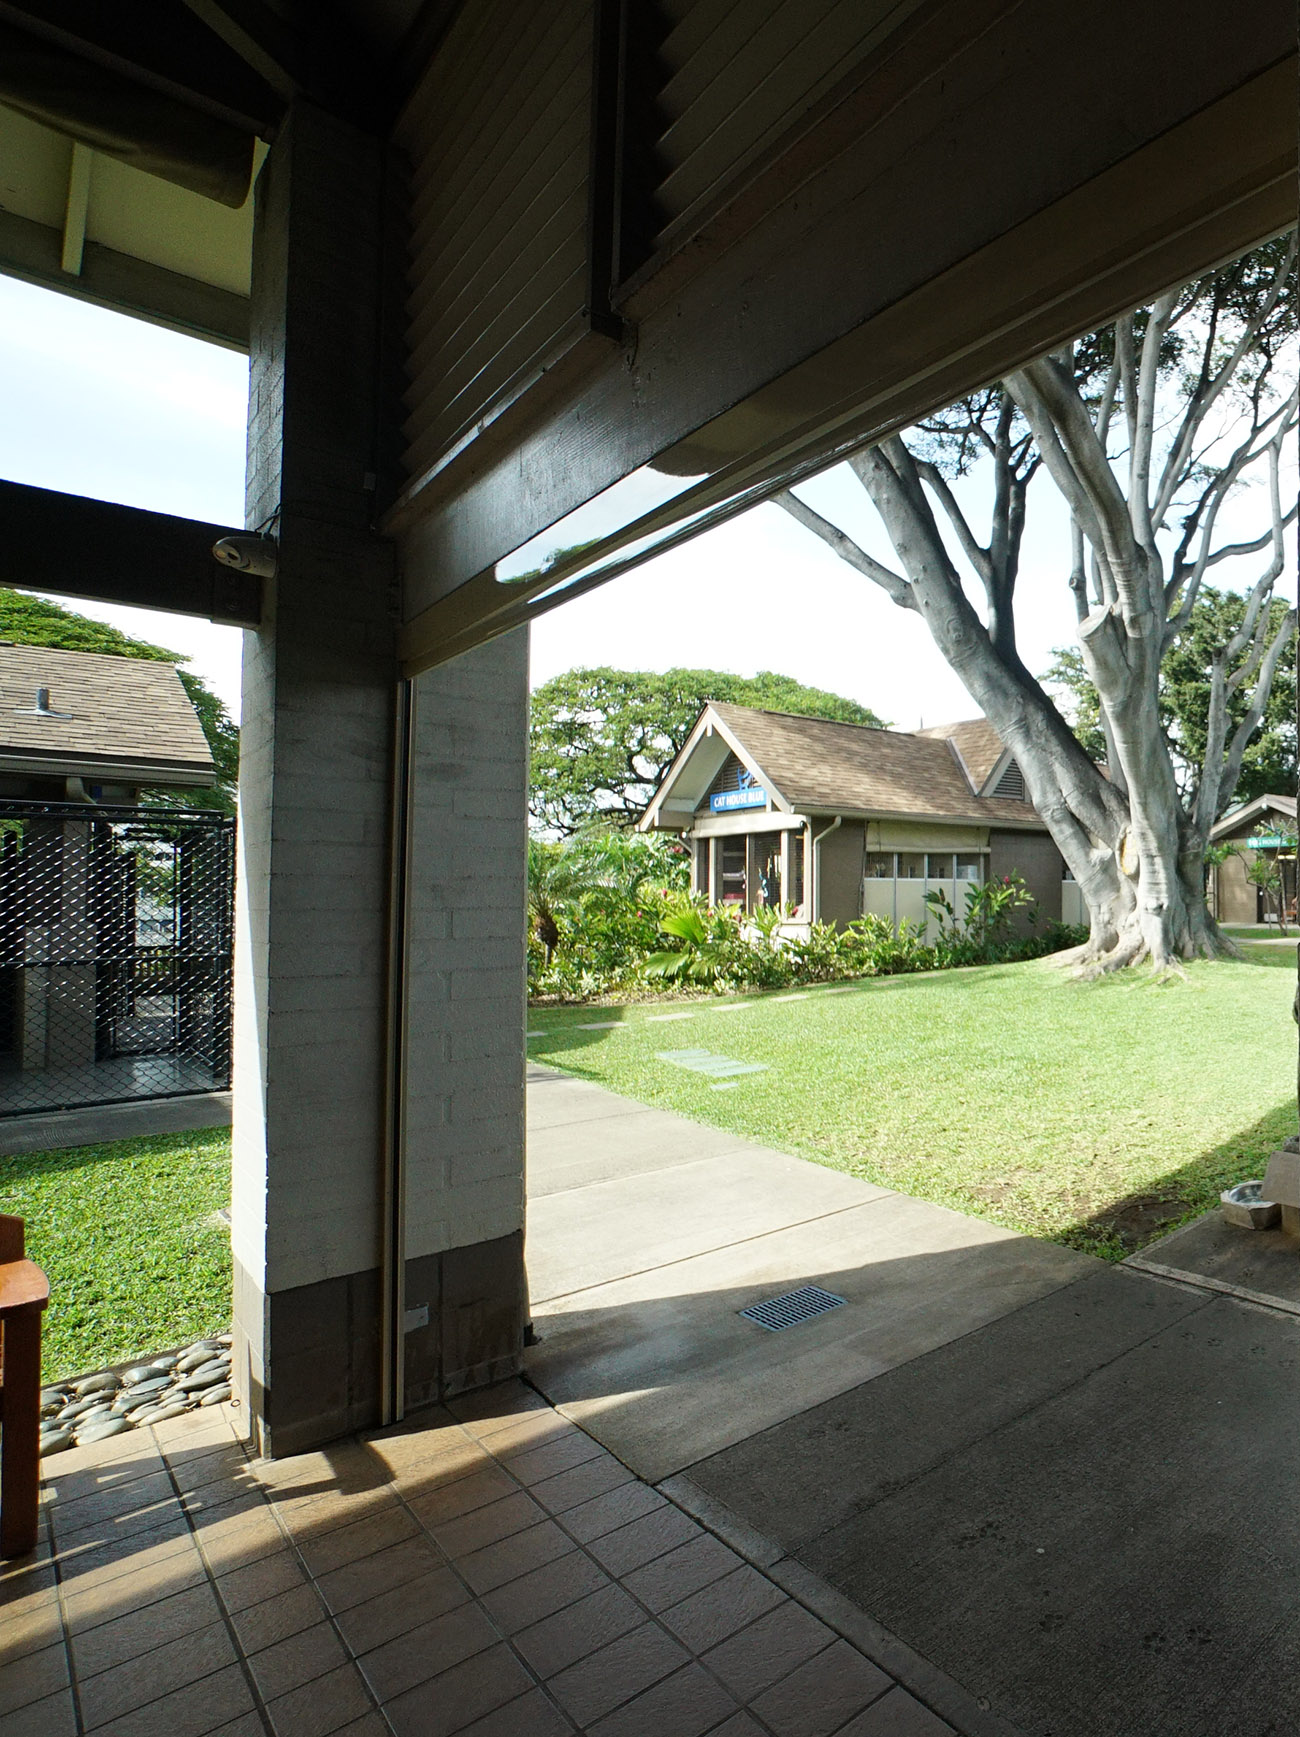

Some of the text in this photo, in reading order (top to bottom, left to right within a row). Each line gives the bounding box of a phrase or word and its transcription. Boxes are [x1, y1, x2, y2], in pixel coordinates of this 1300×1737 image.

[713, 790, 765, 808] CAT HOUSE BLUE
